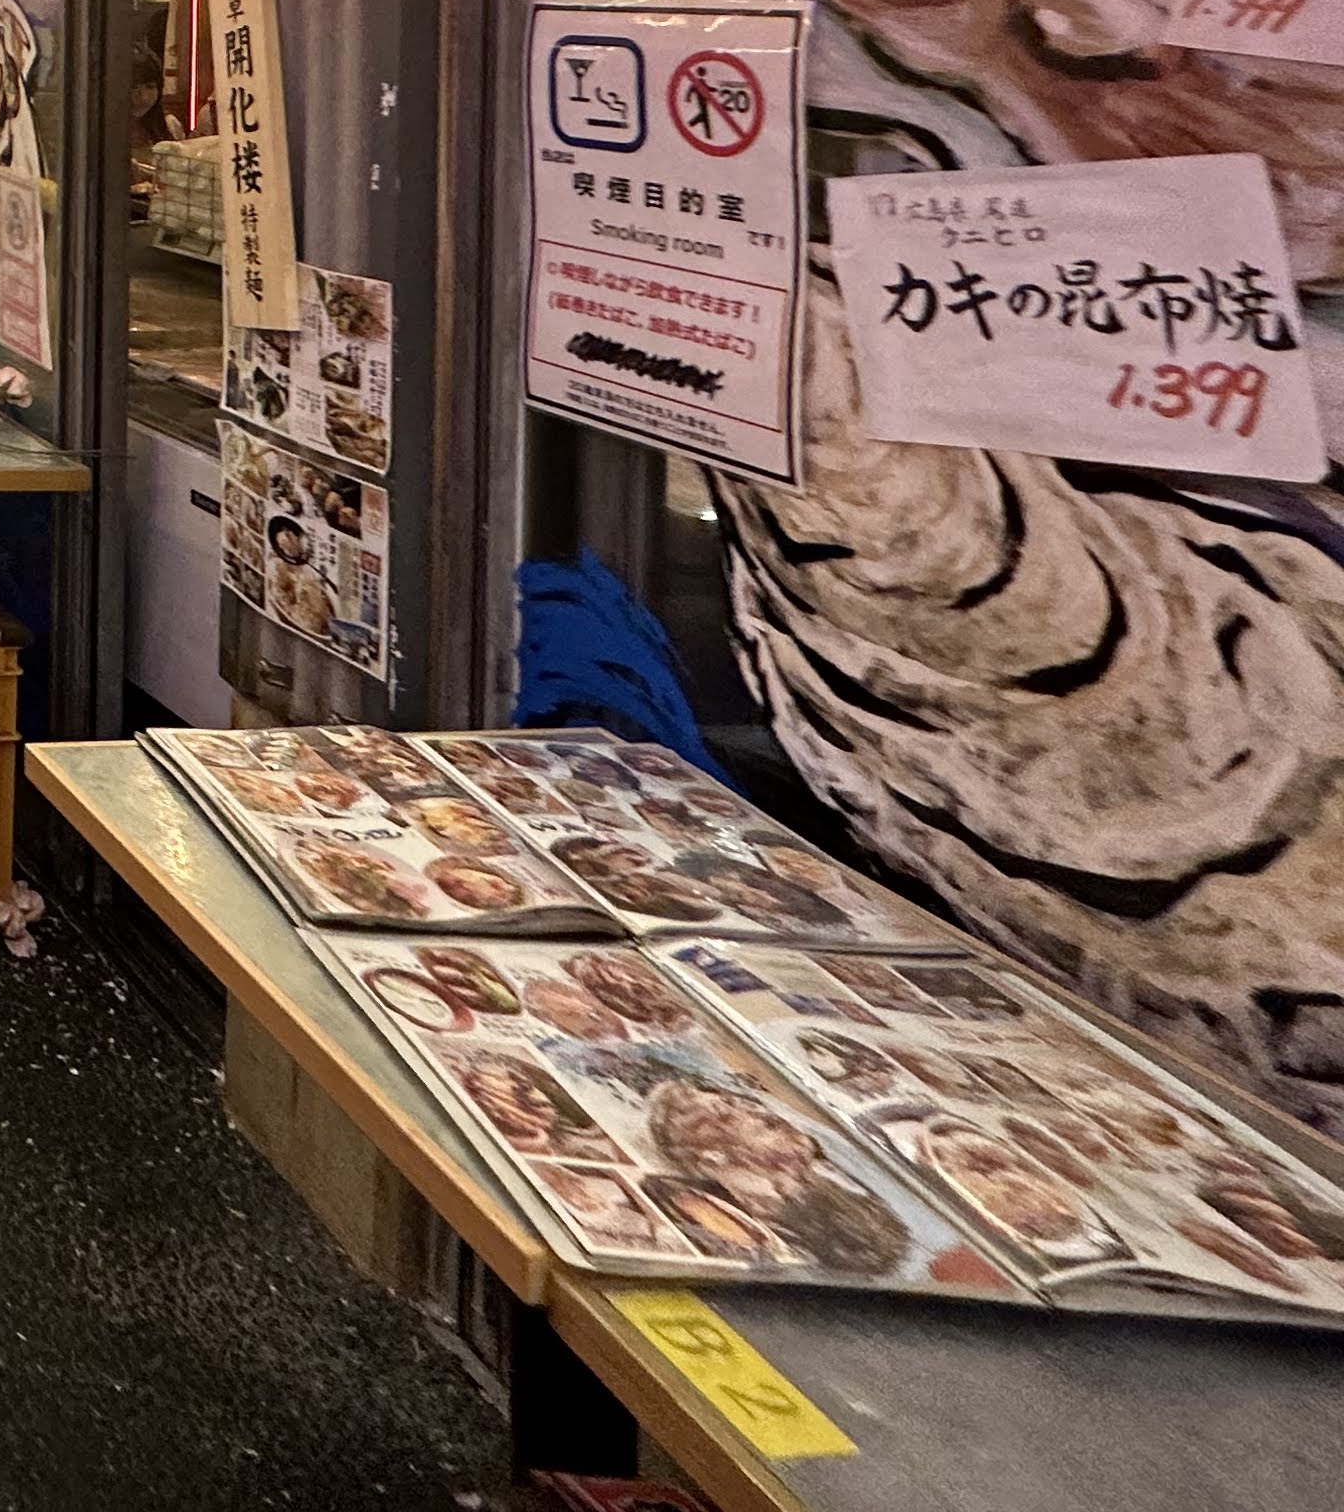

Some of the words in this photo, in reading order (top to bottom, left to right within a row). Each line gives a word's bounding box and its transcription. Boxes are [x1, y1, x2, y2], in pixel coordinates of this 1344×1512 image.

[573, 172, 745, 223] 喫煙目的室
[591, 218, 669, 252] Smoking
[671, 236, 724, 260] room
[881, 259, 1299, 355] カキの昆布焼
[1106, 362, 1270, 438] 1.399
